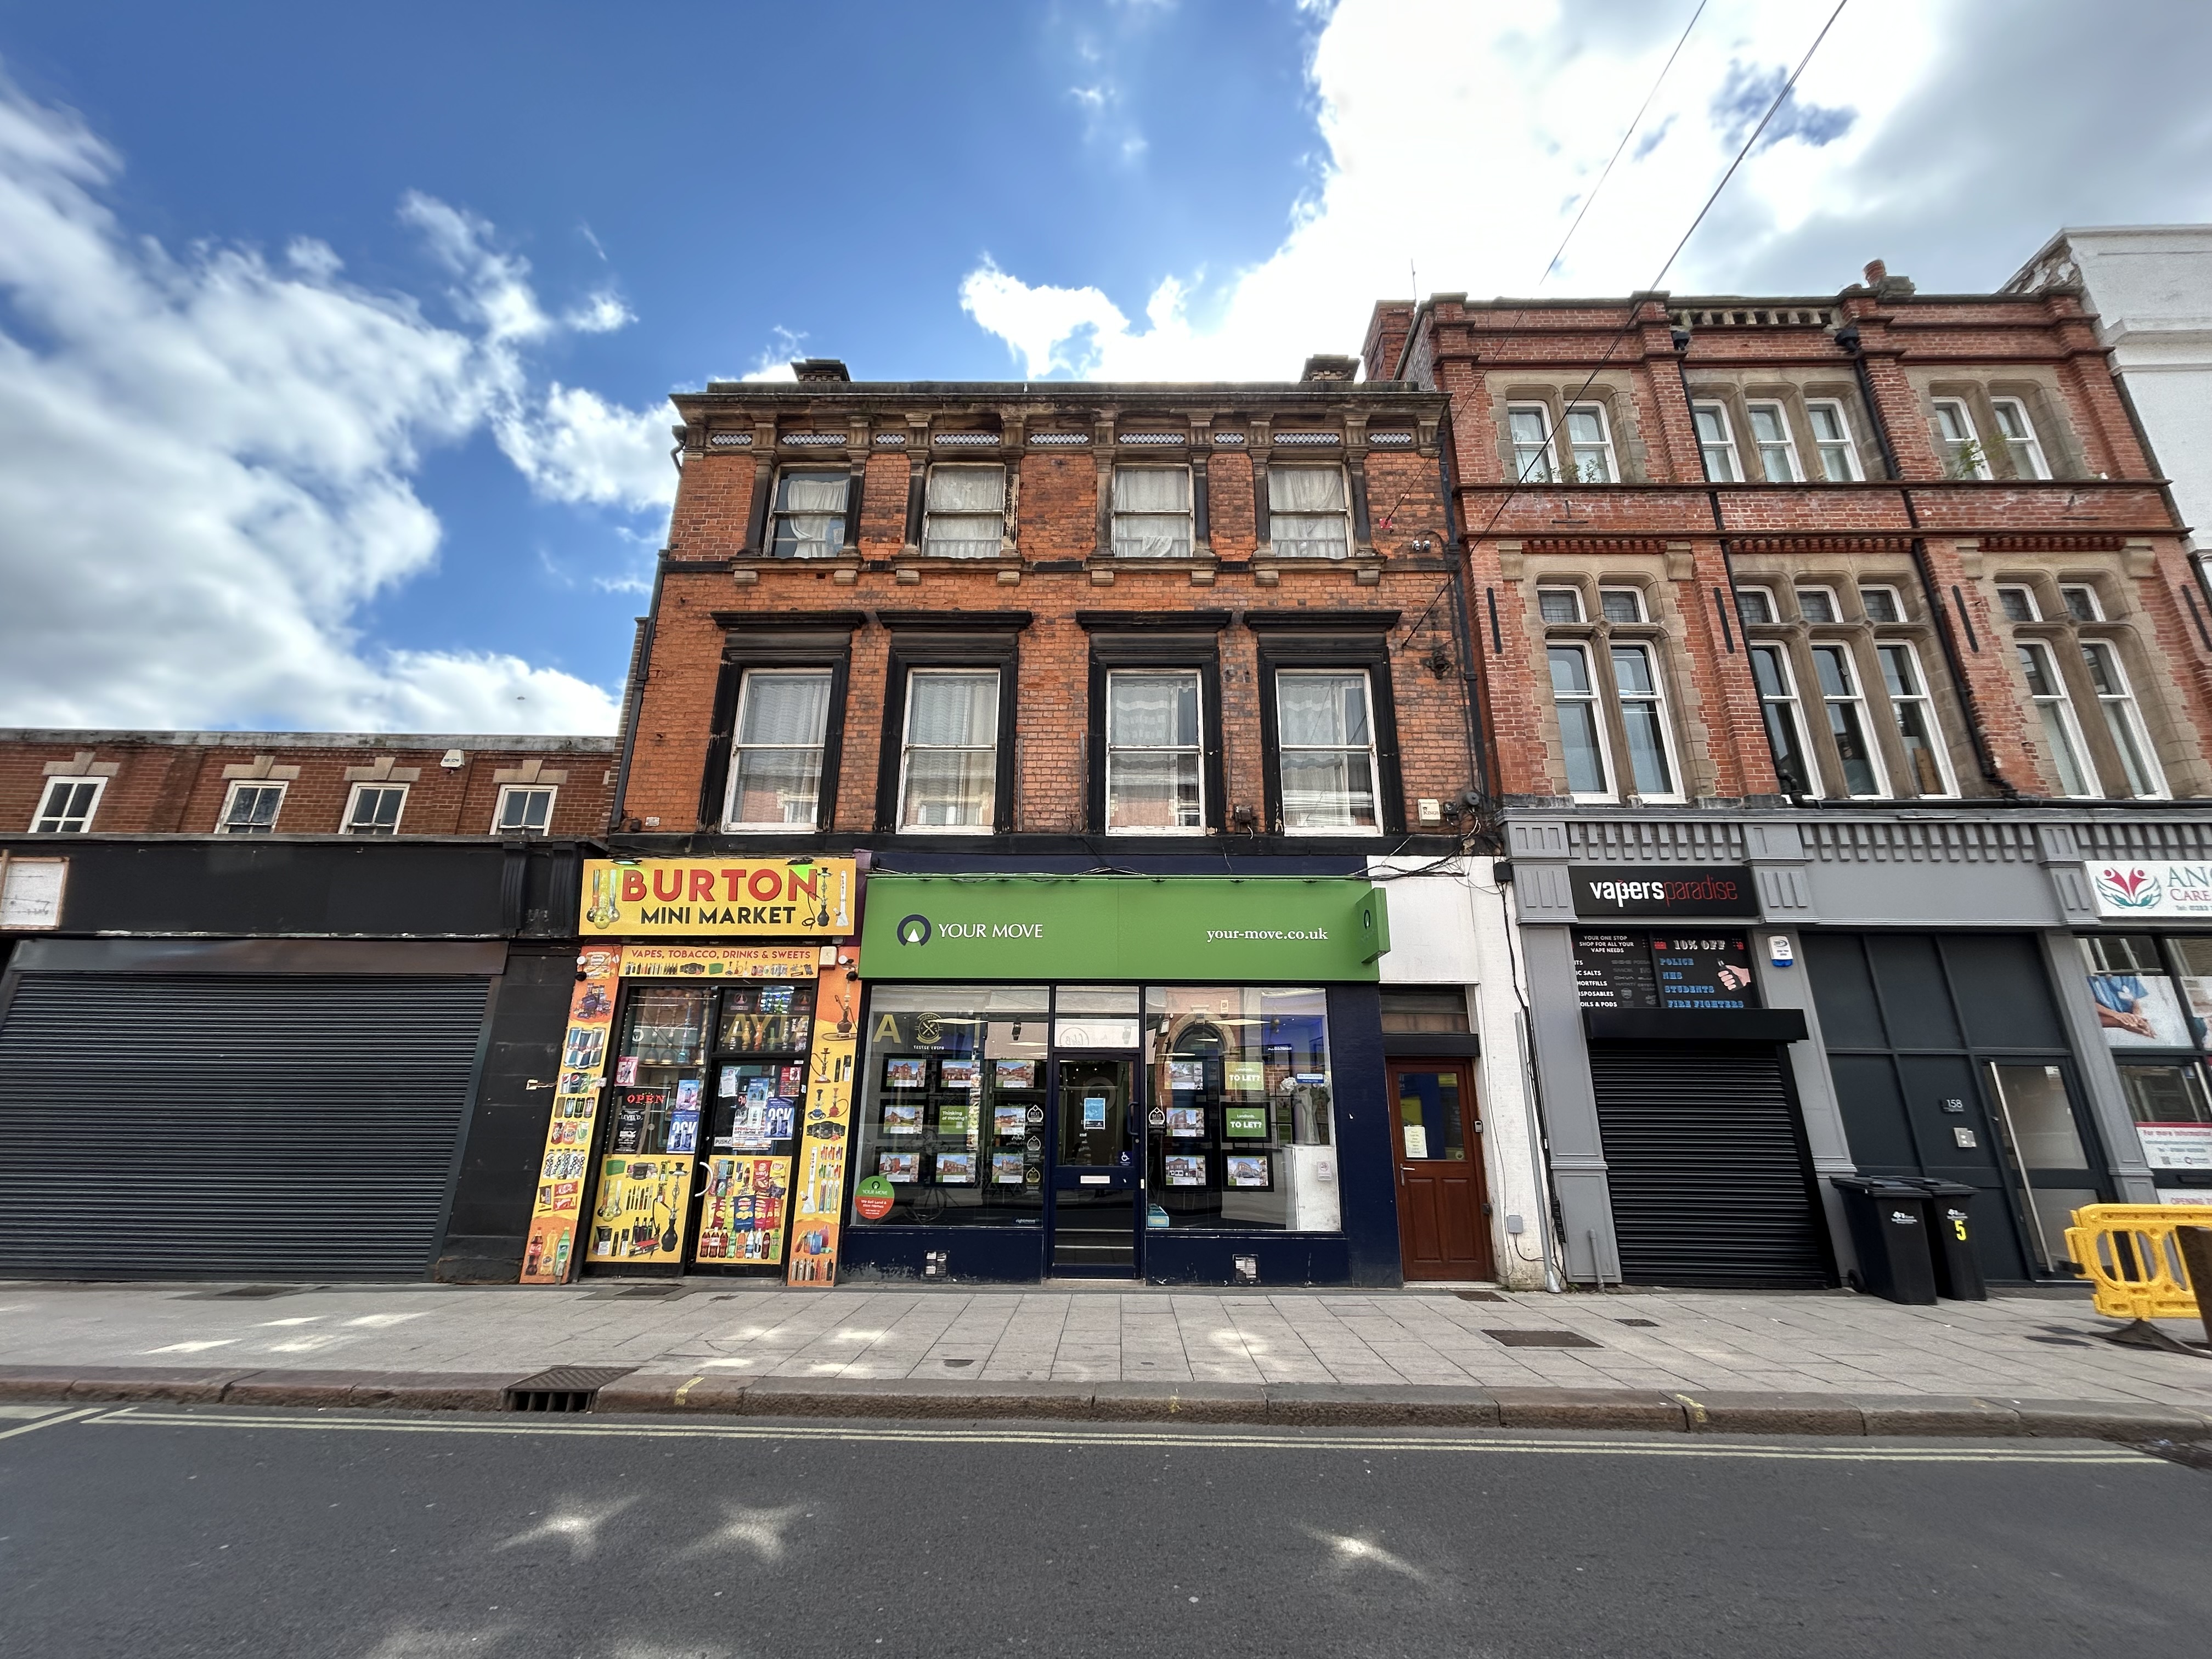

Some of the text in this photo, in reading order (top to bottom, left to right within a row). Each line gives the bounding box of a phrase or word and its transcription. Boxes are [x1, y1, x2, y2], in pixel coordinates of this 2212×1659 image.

[2167, 866, 2212, 887] AN
[622, 868, 817, 902] BURTON
[641, 906, 796, 924] MINI MARKET
[938, 923, 1043, 938] YOUR MOVE
[1206, 927, 1328, 943] your-move.co.uk
[1673, 939, 1725, 950] 10% OFF
[631, 950, 665, 960] VAPES,
[668, 950, 719, 960] TOBACCO,
[723, 950, 759, 959] DRINKS
[771, 951, 811, 959] SWEETS
[1667, 1000, 1744, 1008] FIRE FIGHTERS
[627, 1094, 666, 1104] OPEN
[1946, 1099, 1962, 1108] 158
[1954, 1220, 1966, 1240] 5
